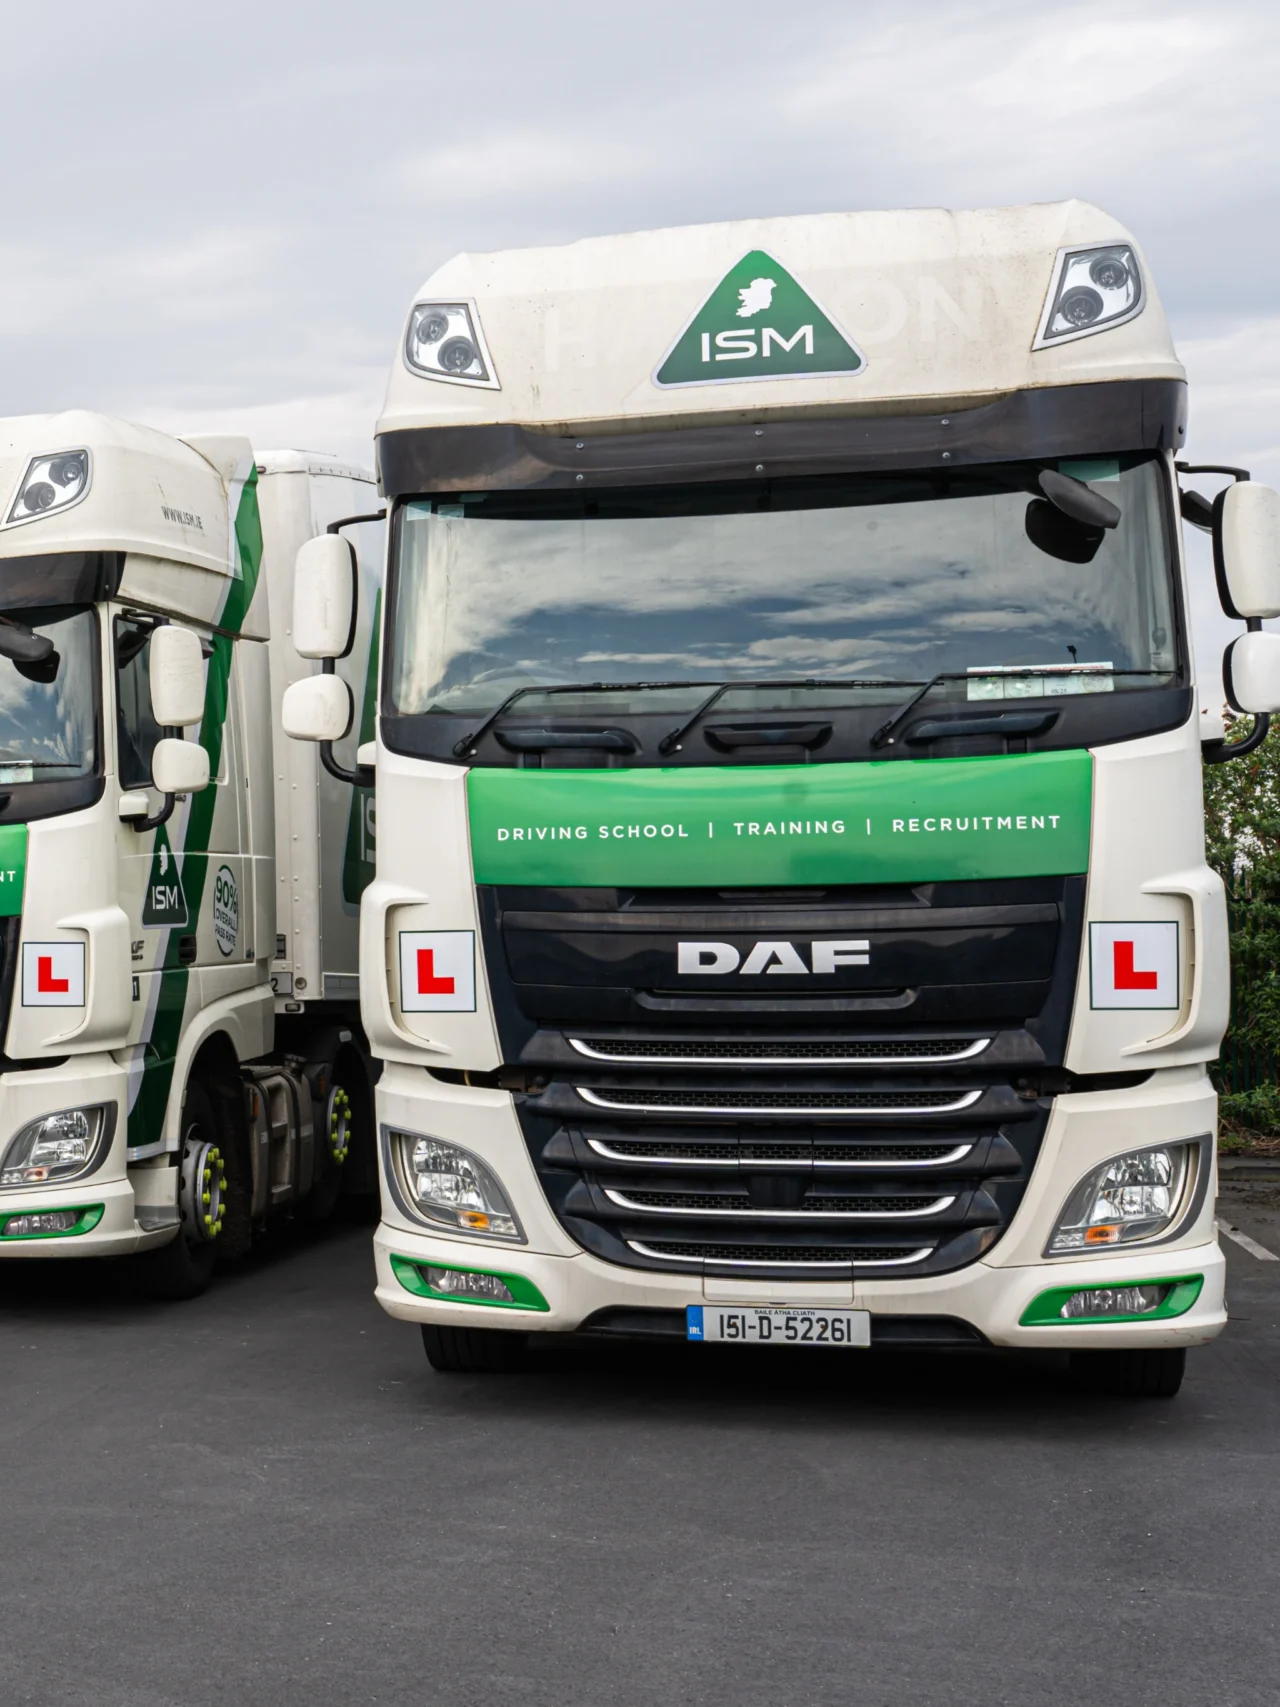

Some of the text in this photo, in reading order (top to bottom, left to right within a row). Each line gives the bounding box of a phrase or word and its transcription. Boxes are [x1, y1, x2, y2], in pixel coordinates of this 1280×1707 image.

[702, 324, 814, 362] ISM
[497, 815, 1061, 842] DRIVING SCHOOL TRAINING RECRUITMENT
[152, 885, 178, 910] ISM
[216, 875, 237, 914] 90%
[38, 956, 69, 992] L
[417, 949, 455, 994] L
[678, 940, 870, 975] DAF
[1114, 941, 1157, 990] L
[689, 1326, 702, 1335] IRL
[720, 1314, 852, 1343] 151-D-52261
